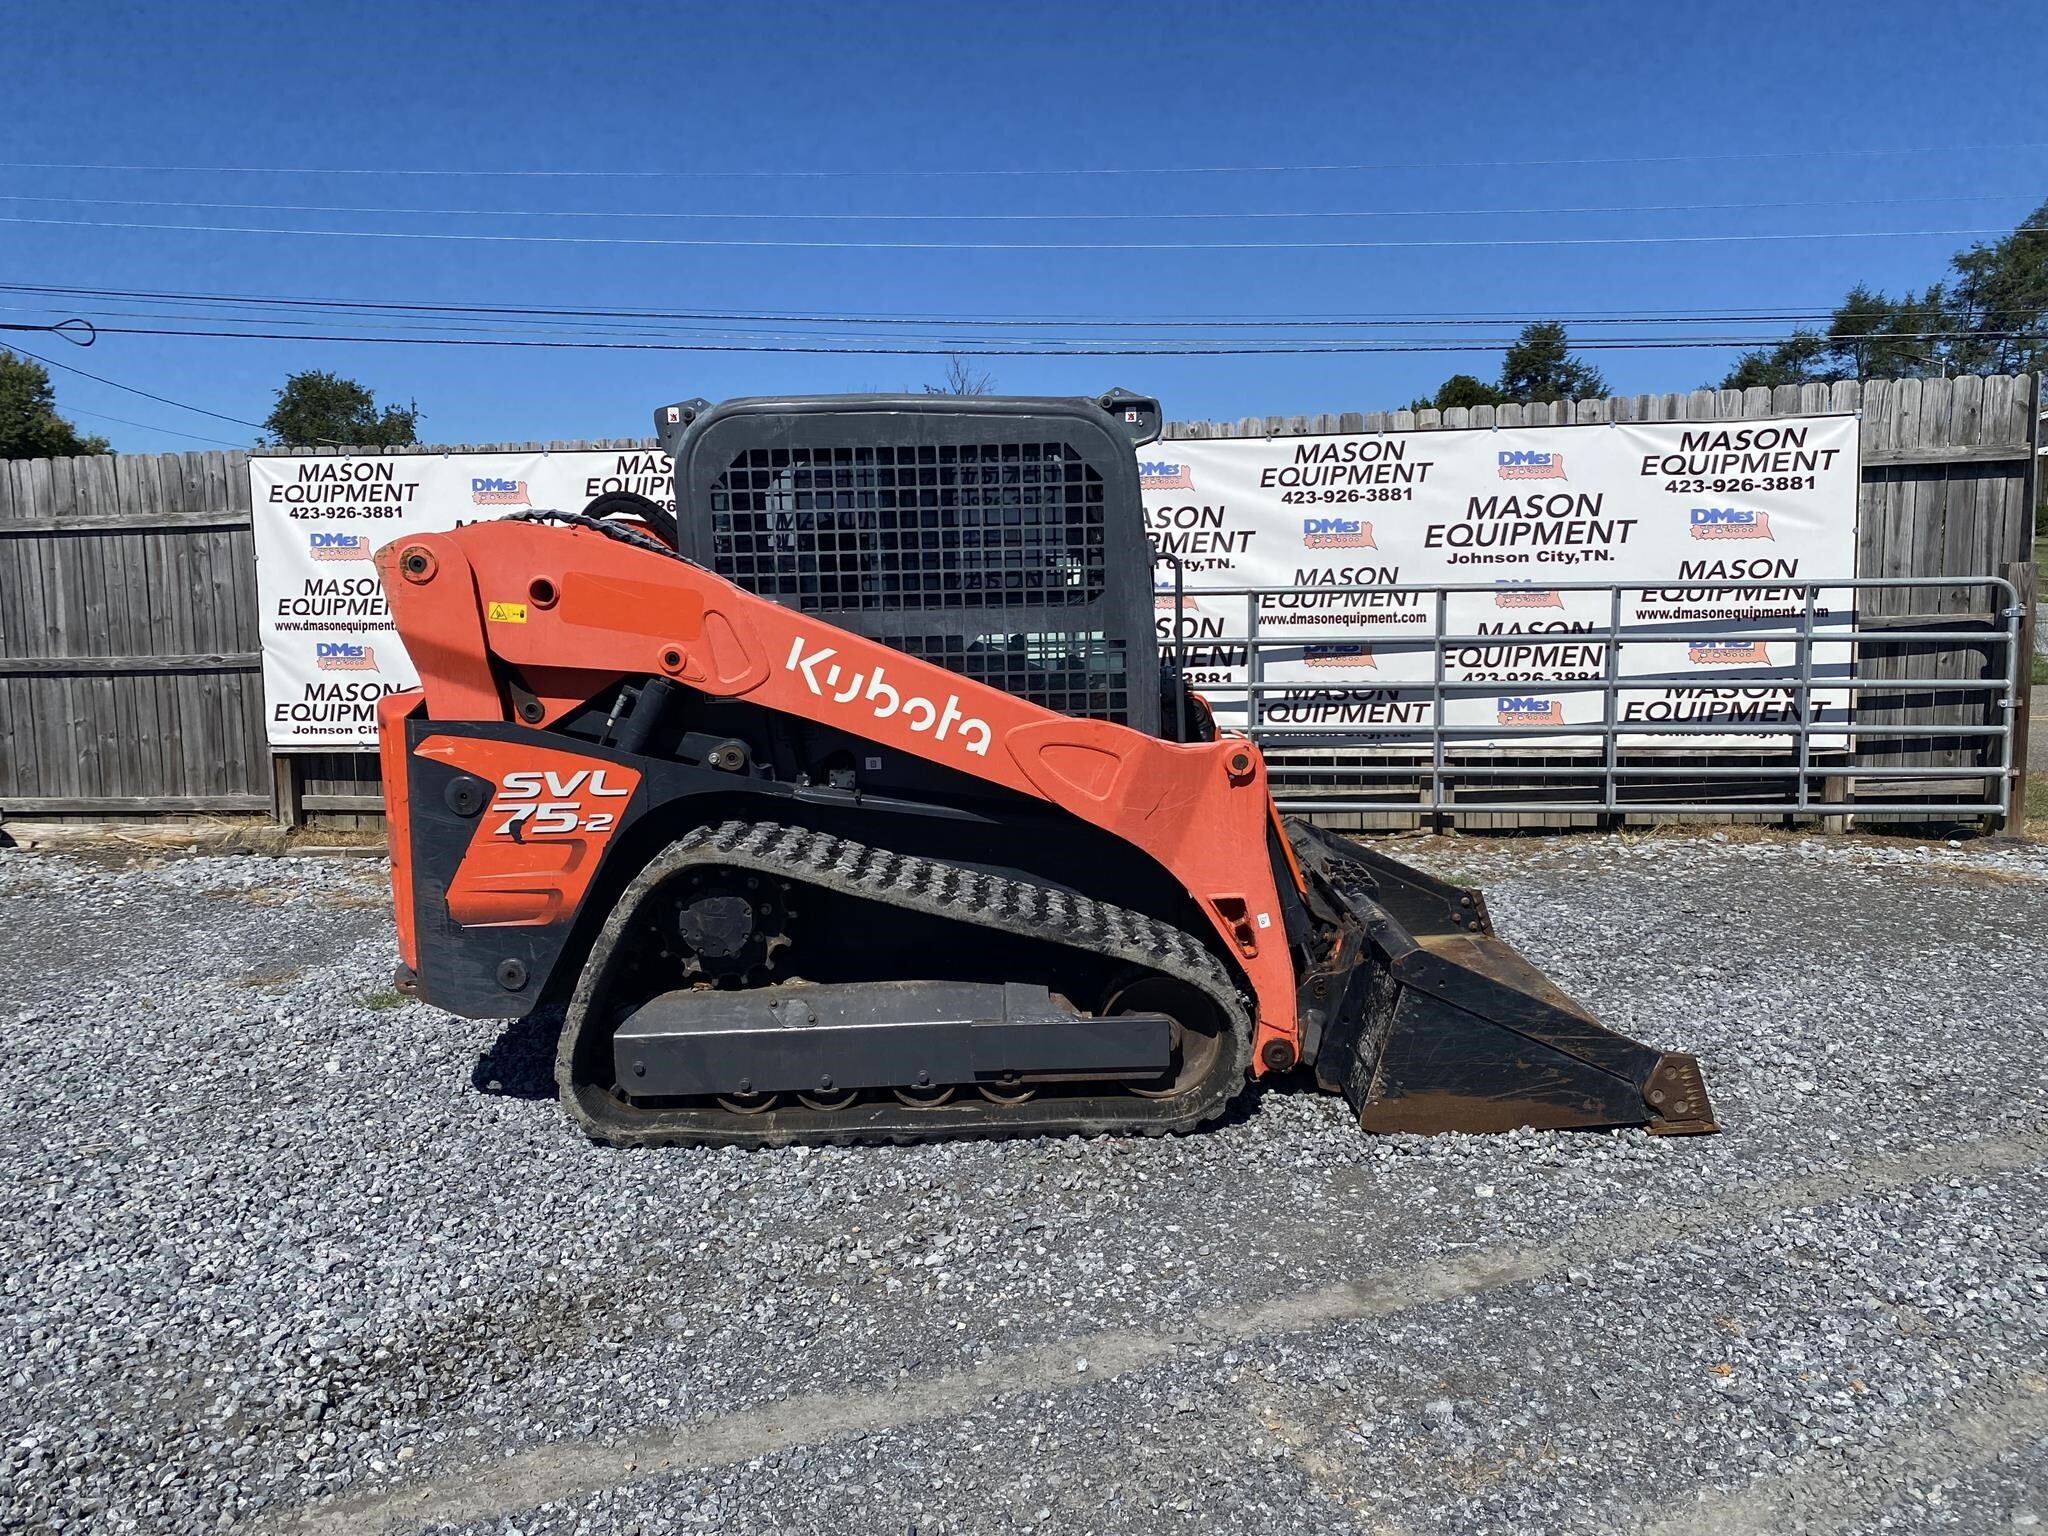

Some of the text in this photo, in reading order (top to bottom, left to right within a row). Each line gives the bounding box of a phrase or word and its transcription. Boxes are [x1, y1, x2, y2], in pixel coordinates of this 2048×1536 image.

[1680, 427, 1808, 452] MASON
[1294, 440, 1406, 464] MASON
[1640, 449, 1840, 476] EQUIPMENT
[298, 462, 394, 483] MASON
[1260, 462, 1433, 488] EQUIPMENT
[268, 483, 420, 503] EQUIPMENT
[1665, 476, 1815, 493] 423-926-3881
[1281, 487, 1413, 504] 423-926-3881
[289, 506, 403, 519] 423-926-3881
[1466, 493, 1603, 520] MASON
[1424, 519, 1638, 548] EQUIPMENT
[1447, 550, 1615, 565] Johnson City,TN.
[1294, 567, 1399, 586] MASON
[1678, 559, 1799, 580] MASON
[1261, 591, 1420, 609] EQUIPMENT
[1478, 621, 1594, 636] MASON
[304, 683, 401, 701] MASON
[785, 636, 992, 757] Kubota
[1623, 701, 1831, 723] EQUIPMENT
[292, 726, 353, 735] Johnson
[497, 770, 629, 799] SVL
[492, 802, 614, 835] 75-2
